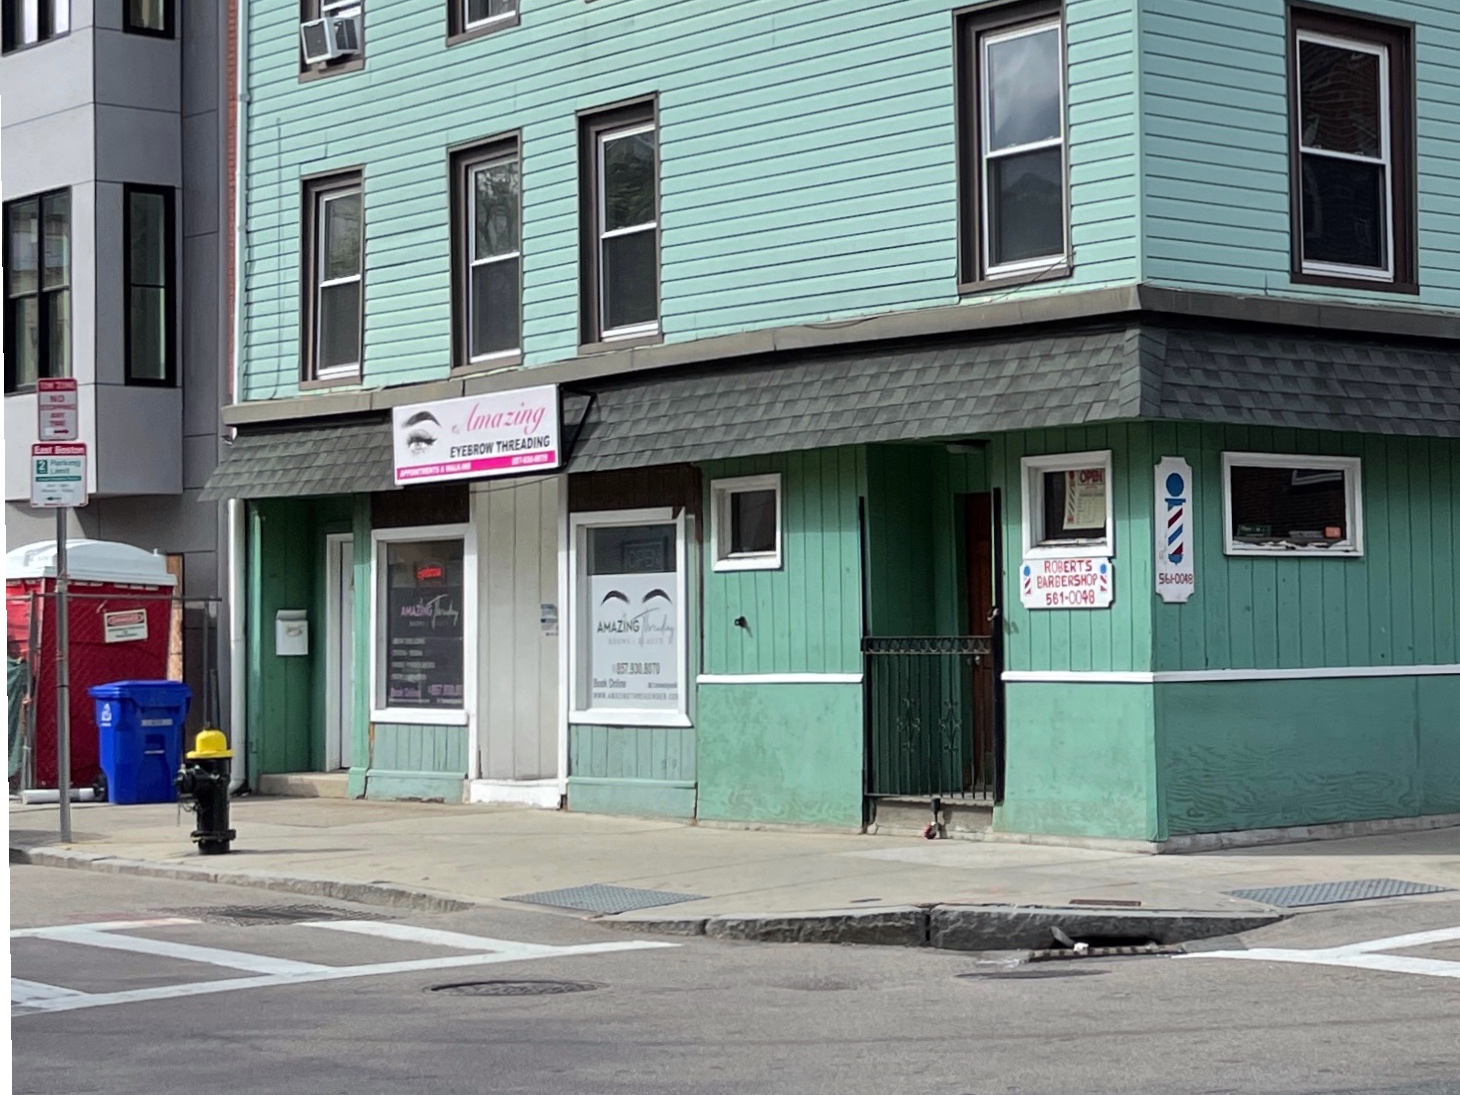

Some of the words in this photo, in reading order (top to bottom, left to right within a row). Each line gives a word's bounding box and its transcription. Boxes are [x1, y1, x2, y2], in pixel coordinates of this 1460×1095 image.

[50, 395, 65, 403] NO
[452, 403, 546, 435] Amazing
[450, 442, 494, 459] EYEBROW
[496, 435, 550, 454] THREADING
[39, 460, 46, 471] 2
[1044, 559, 1093, 574] ROBERTS
[1036, 572, 1098, 590] BARBERSHOP
[1158, 572, 1194, 585] 561-0048
[1045, 589, 1096, 606] 561-0048
[596, 619, 640, 633] AMAZING
